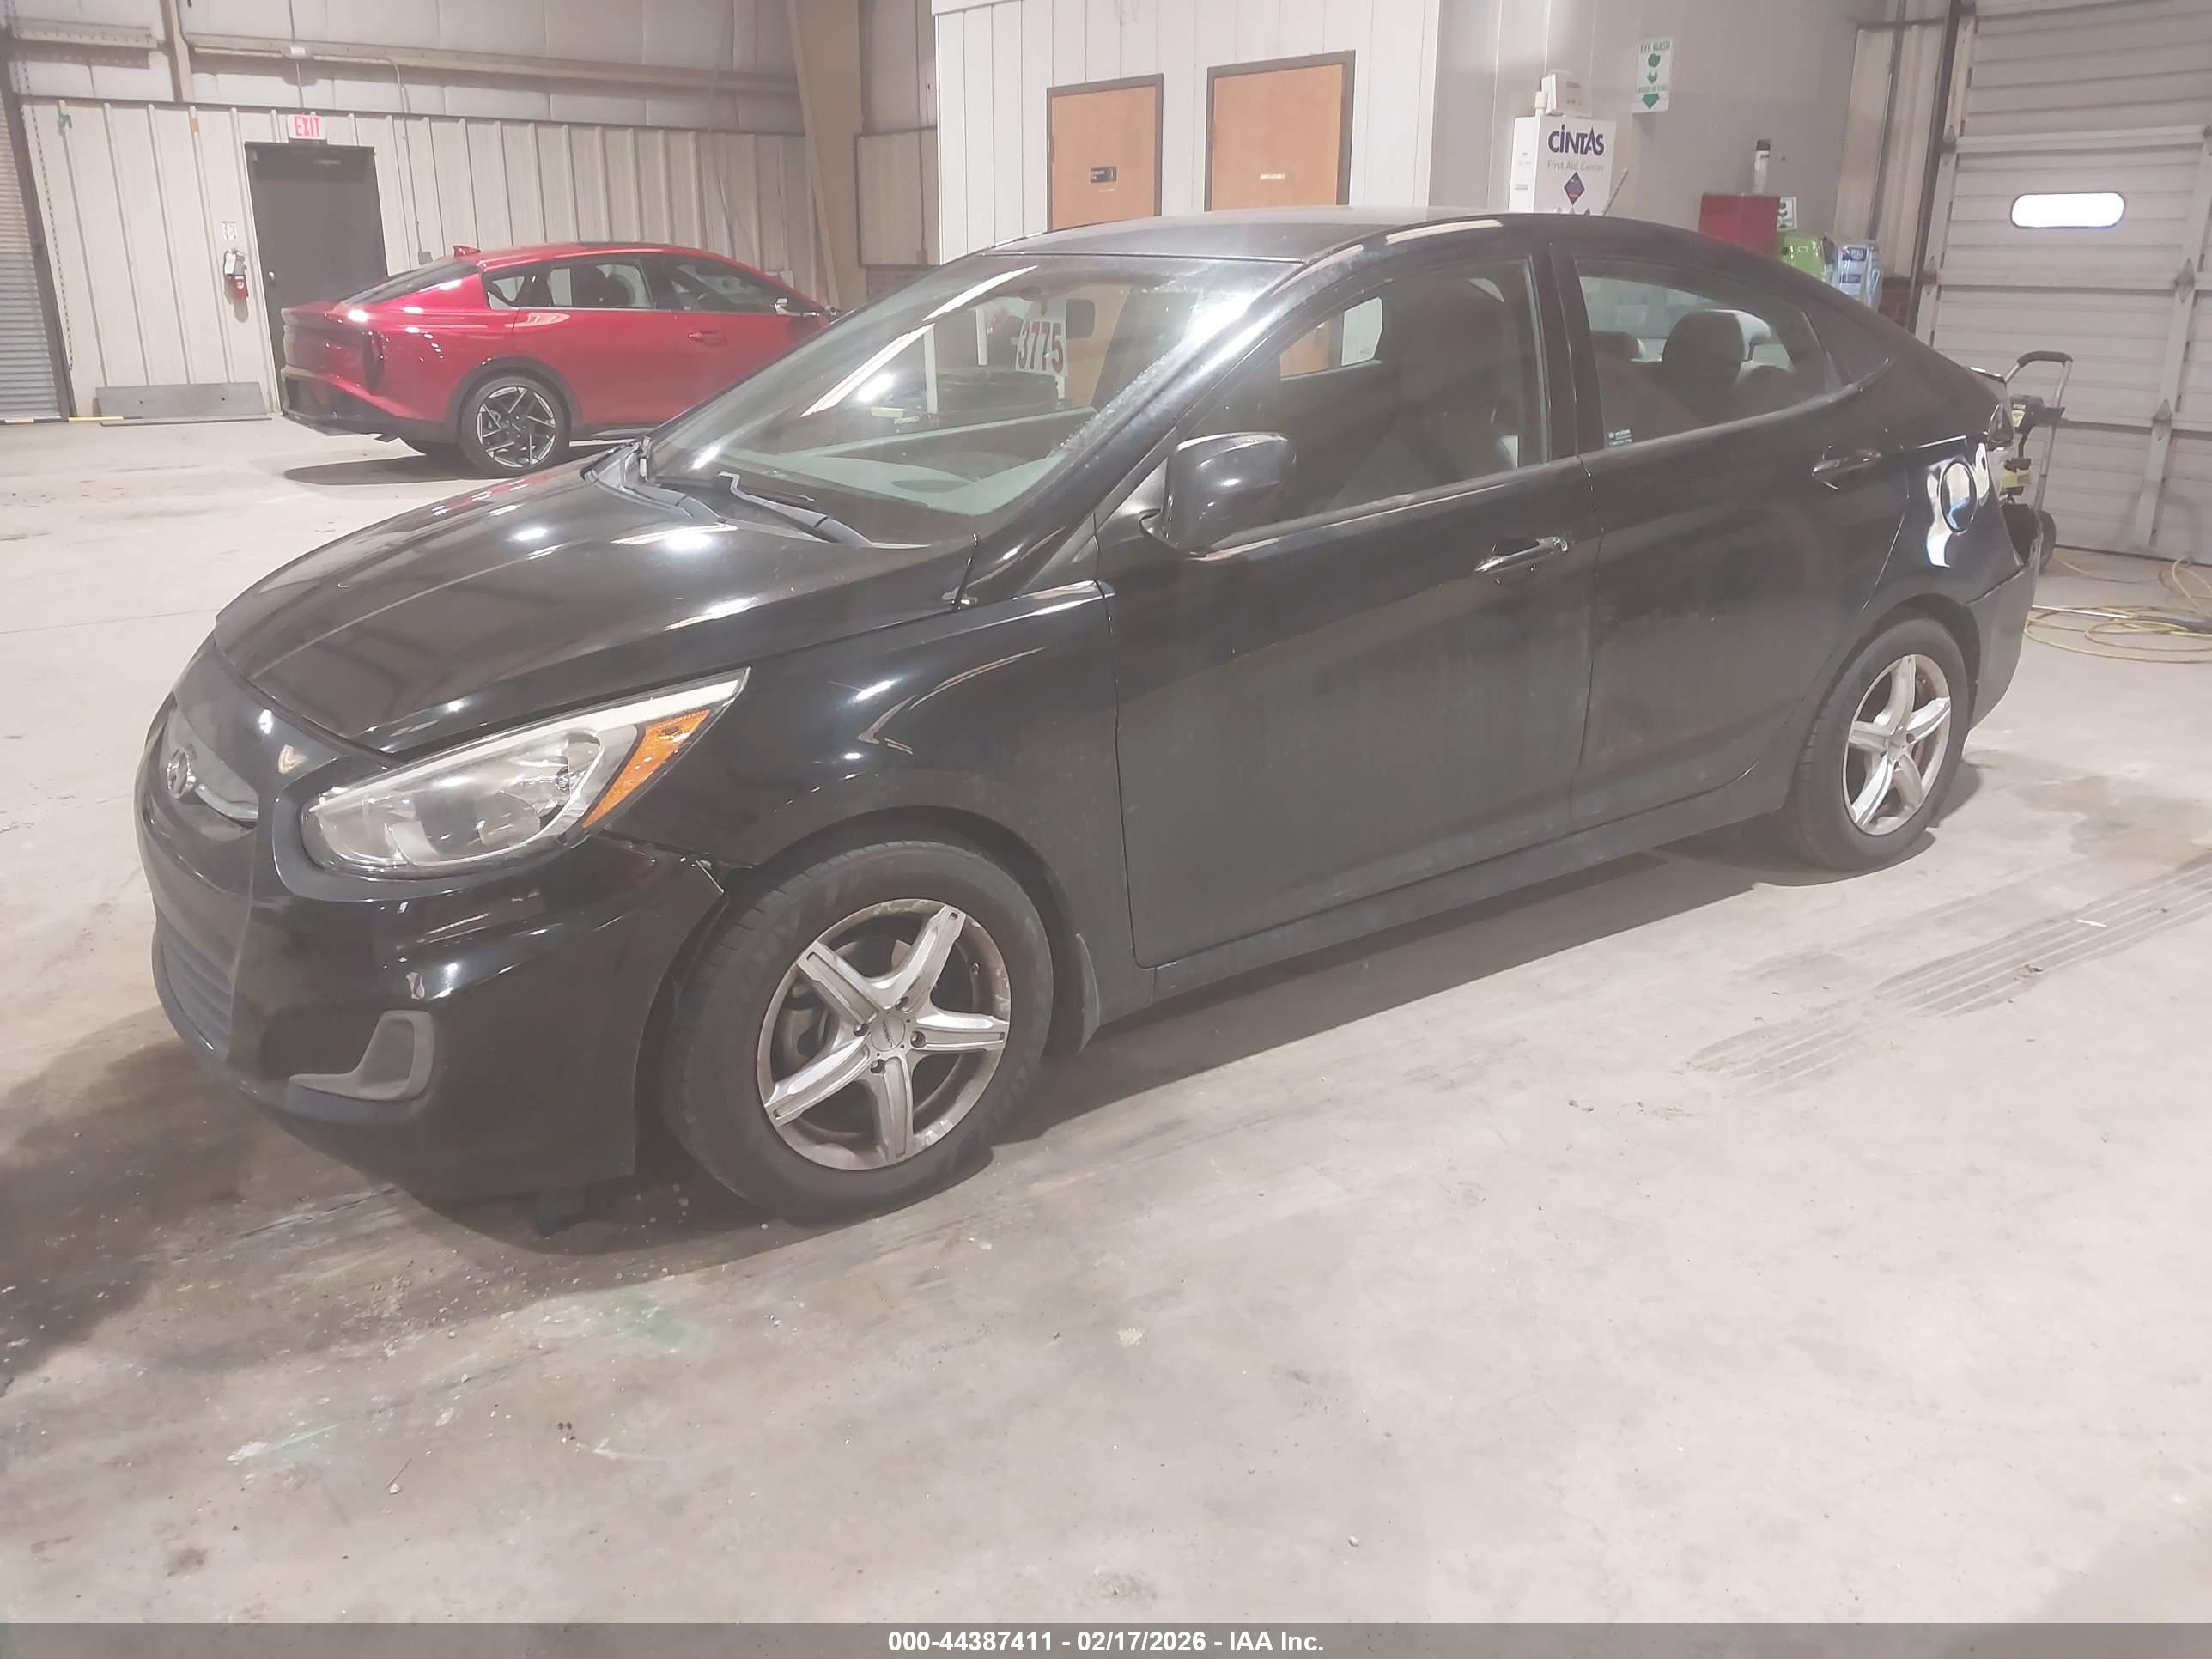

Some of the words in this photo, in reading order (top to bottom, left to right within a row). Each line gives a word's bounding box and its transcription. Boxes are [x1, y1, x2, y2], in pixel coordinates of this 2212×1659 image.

[295, 116, 320, 137] EXIT
[1547, 160, 1564, 170] First
[1565, 161, 1578, 171] Aid
[1018, 320, 1064, 373] 3775
